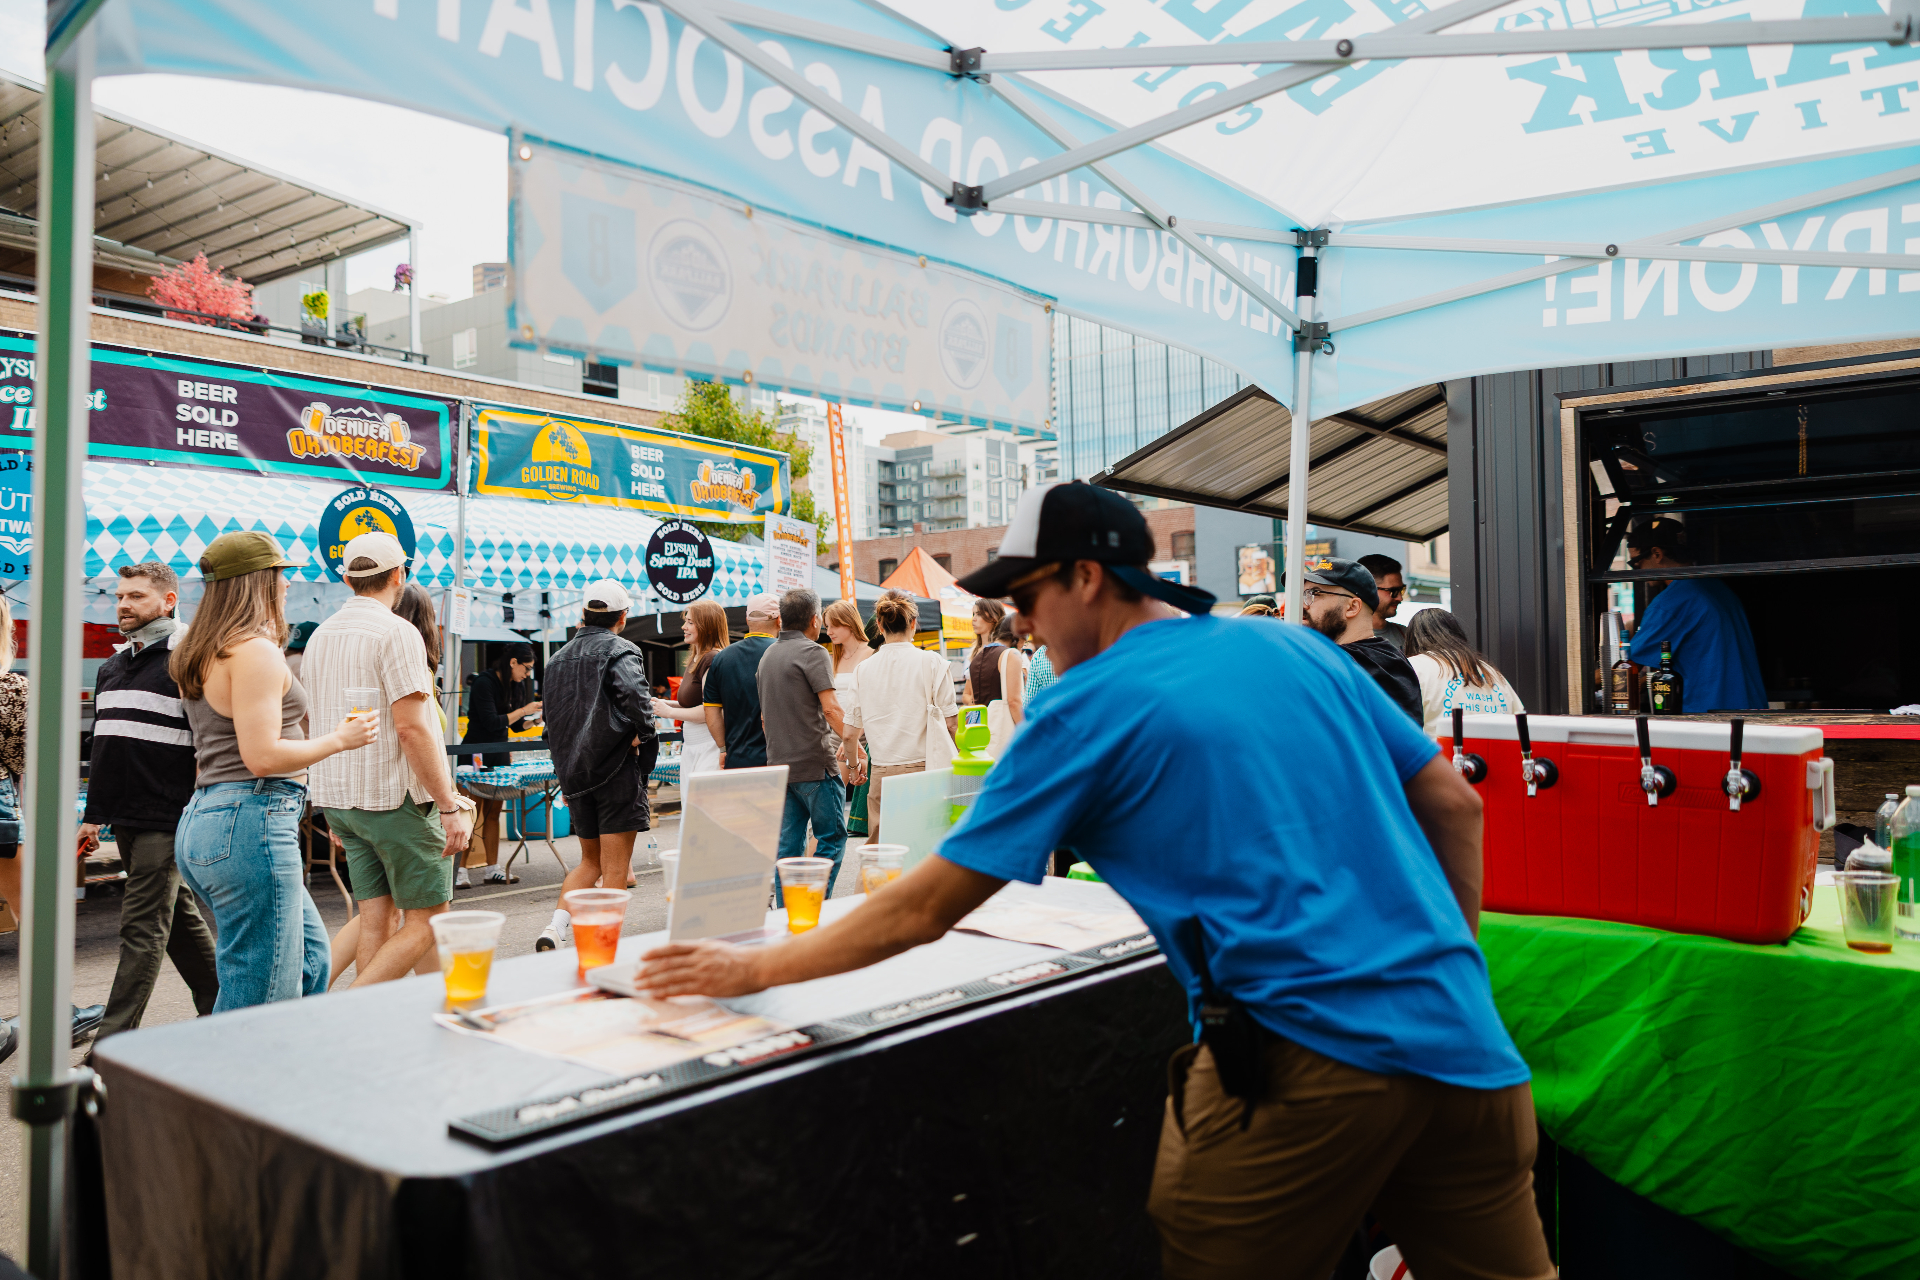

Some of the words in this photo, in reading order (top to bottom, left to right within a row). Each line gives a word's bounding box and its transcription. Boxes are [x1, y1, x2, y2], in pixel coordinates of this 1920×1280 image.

[178, 380, 238, 404] BEER
[176, 403, 239, 427] SOLD
[176, 427, 239, 450] HERE
[325, 418, 390, 441] DENVER
[287, 430, 425, 470] OKTOBERFEST
[631, 445, 664, 463] BEER
[521, 466, 568, 483] GOLDEN
[571, 468, 600, 490] ROAD
[631, 463, 665, 480] SOLD
[711, 472, 743, 489] DENVER
[548, 484, 577, 492] BREWING
[631, 481, 665, 498] HERE
[691, 481, 760, 510] OKTOBERFEST
[334, 490, 366, 511] SOLD
[369, 491, 401, 516] HERE
[656, 521, 680, 539] SOLD
[681, 522, 705, 542] HERE
[664, 542, 698, 558] ELYSIAN
[649, 553, 686, 568] Space
[686, 556, 712, 568] Dust
[676, 566, 698, 579] IPA
[656, 582, 680, 601] SOLD
[681, 582, 706, 601] HERE
[1466, 692, 1493, 702] WASH
[1458, 702, 1480, 712] THIS
